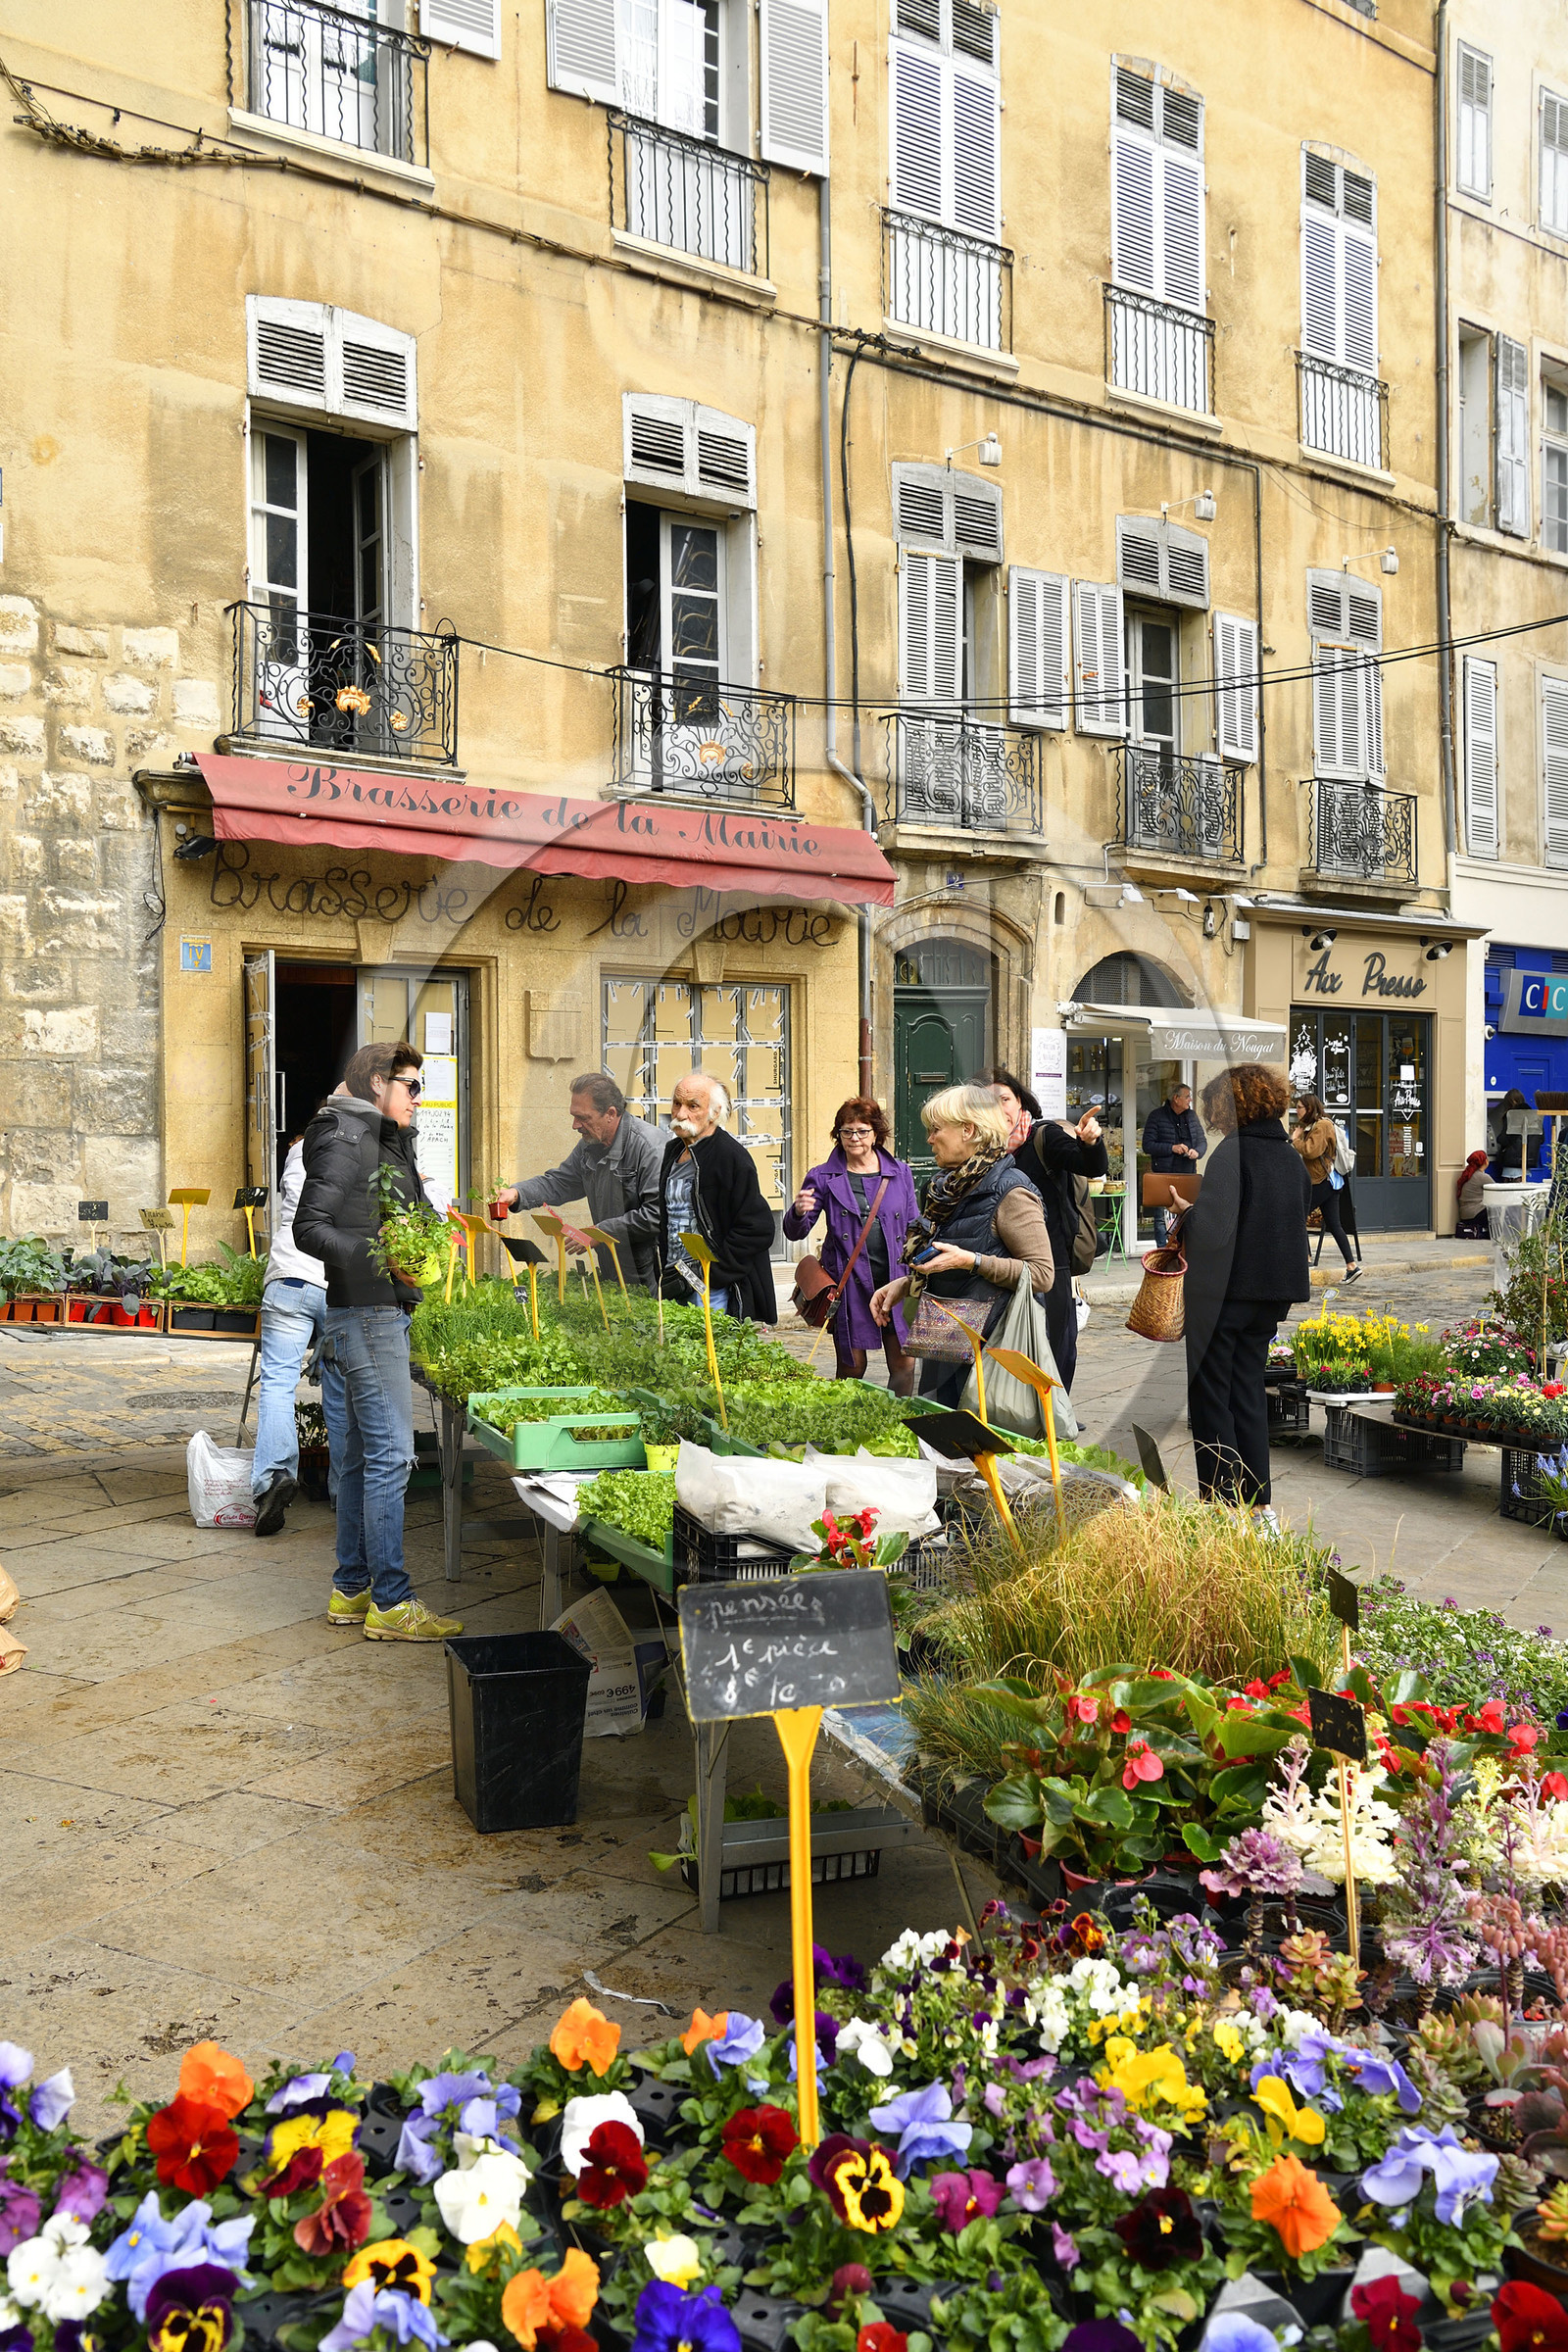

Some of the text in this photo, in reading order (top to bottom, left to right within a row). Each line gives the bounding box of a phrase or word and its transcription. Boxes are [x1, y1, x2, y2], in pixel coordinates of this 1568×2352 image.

[287, 762, 822, 858] Brasserie de la Mairie
[209, 841, 844, 948] Brasserie de la Mairie
[1304, 950, 1427, 998] Aix Presso
[1525, 983, 1566, 1011] CIC
[1164, 1030, 1275, 1060] Maison du Nougat
